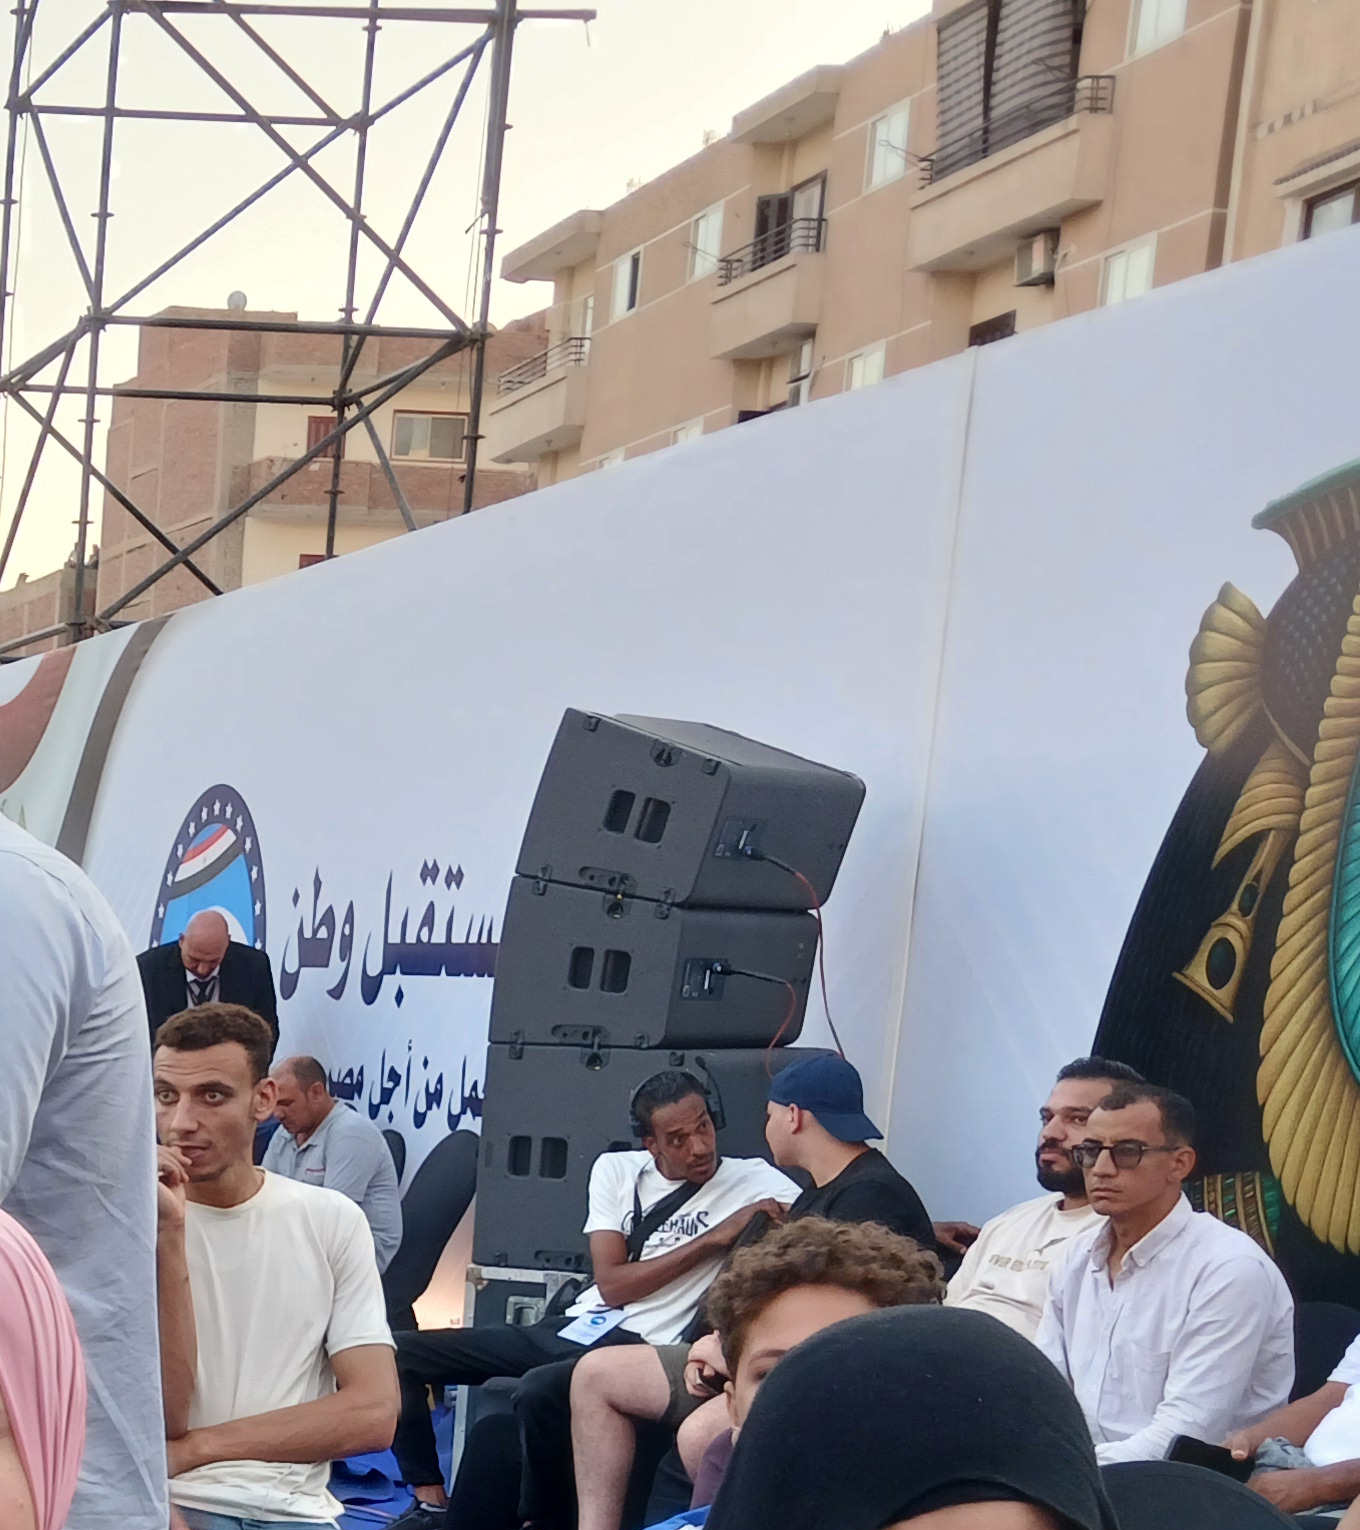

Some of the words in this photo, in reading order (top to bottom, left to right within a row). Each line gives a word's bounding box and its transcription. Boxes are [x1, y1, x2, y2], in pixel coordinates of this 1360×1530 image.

[280, 865, 355, 1001] وطن
[361, 858, 500, 1009] ستقبل
[329, 1064, 365, 1101] مص
[368, 1039, 413, 1124] أجل
[413, 1056, 443, 1129] من
